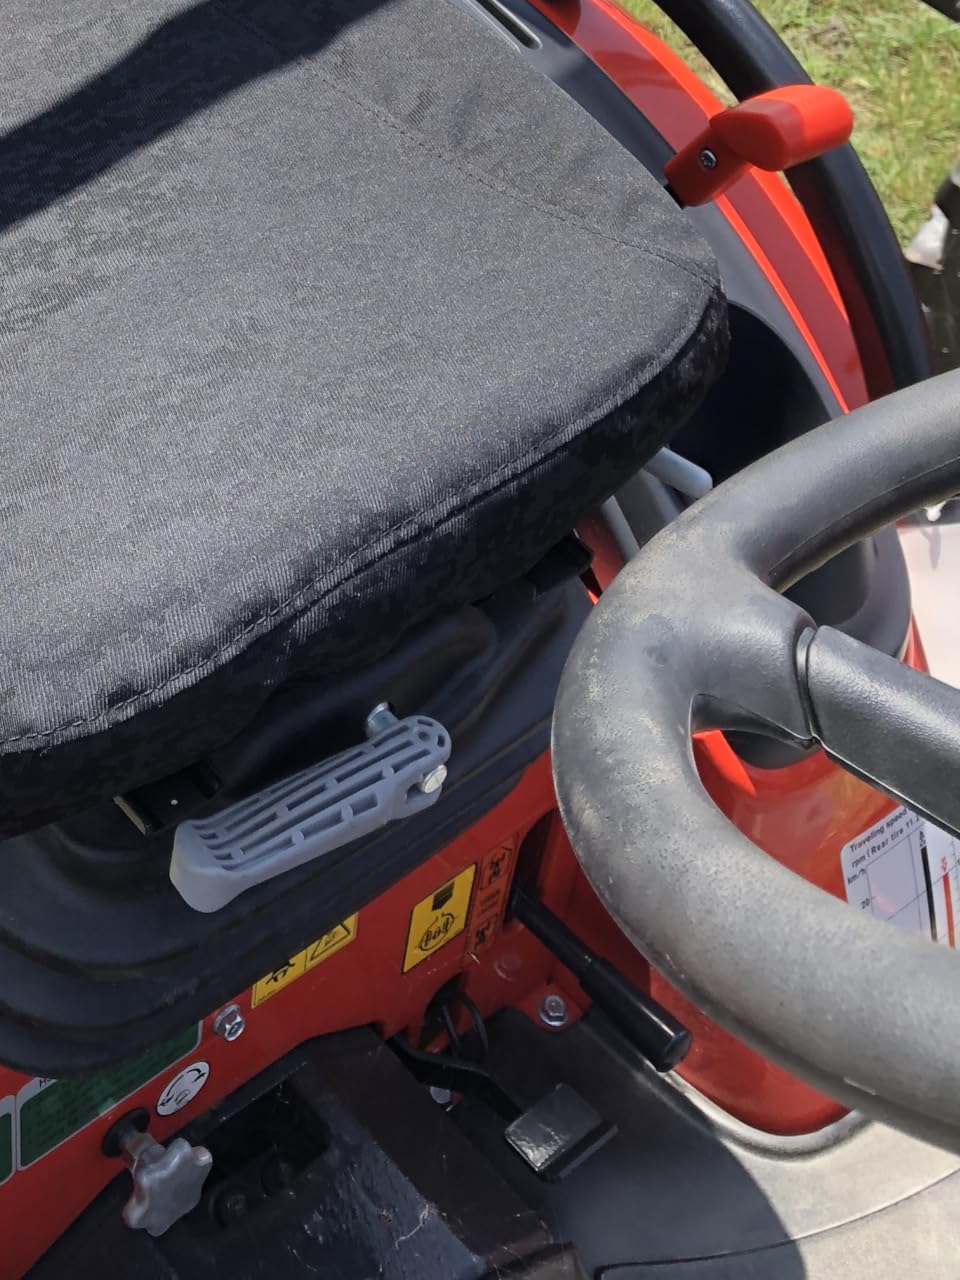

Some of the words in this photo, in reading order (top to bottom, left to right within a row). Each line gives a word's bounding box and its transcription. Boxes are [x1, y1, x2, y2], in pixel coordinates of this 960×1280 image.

[849, 825, 885, 853] Traveling
[886, 807, 908, 829] speed
[851, 854, 866, 868] rpm
[890, 828, 904, 841] tire
[847, 867, 866, 885] km/h
